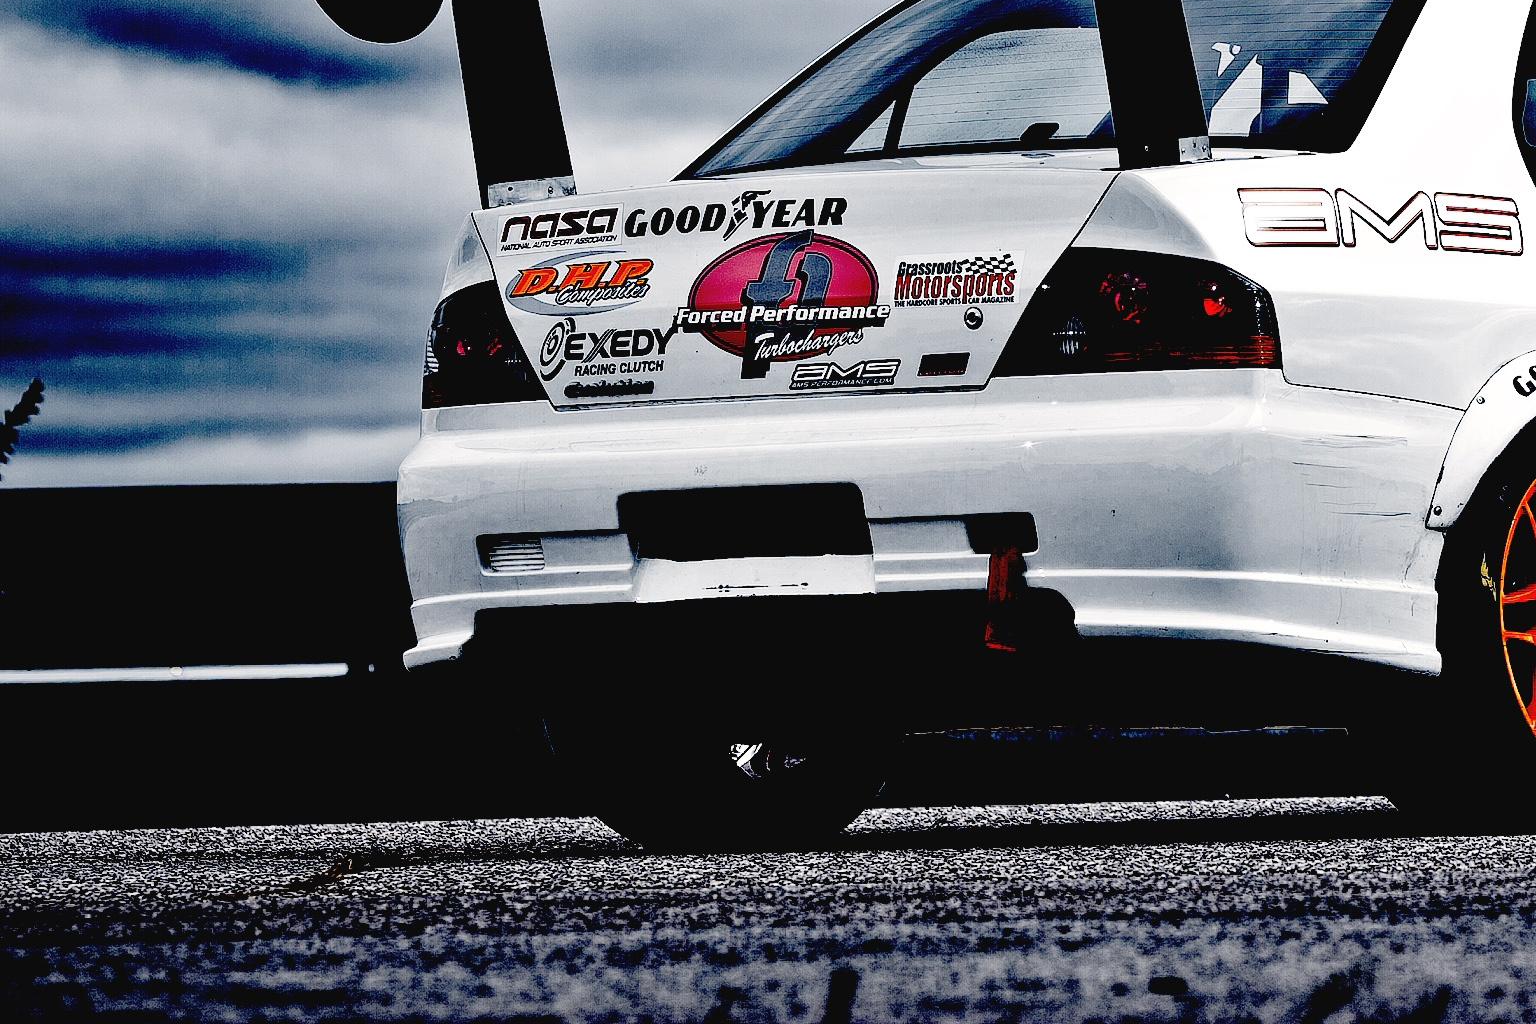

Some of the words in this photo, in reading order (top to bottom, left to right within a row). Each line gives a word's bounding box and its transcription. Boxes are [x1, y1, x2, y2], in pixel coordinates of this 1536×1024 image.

[500, 242, 531, 251] NATIONAL
[532, 240, 551, 248] AUTO
[551, 238, 574, 247] SPORT
[574, 235, 618, 245] ASSOCIATION
[509, 258, 655, 298] D.H.P.
[897, 260, 963, 276] Grassroots
[555, 281, 651, 306] Composites
[894, 272, 1016, 304] Motorsports
[894, 300, 906, 308] THE
[907, 299, 938, 307] HARDCORE
[939, 298, 961, 306] SPORTS
[981, 296, 1015, 304] MAGAZINE
[677, 307, 747, 324] Forced
[750, 305, 891, 323] Performance
[564, 327, 676, 364] EXEDY
[754, 328, 864, 361] Turbochargers
[574, 363, 617, 377] RACING
[619, 360, 664, 375] CLUTCH
